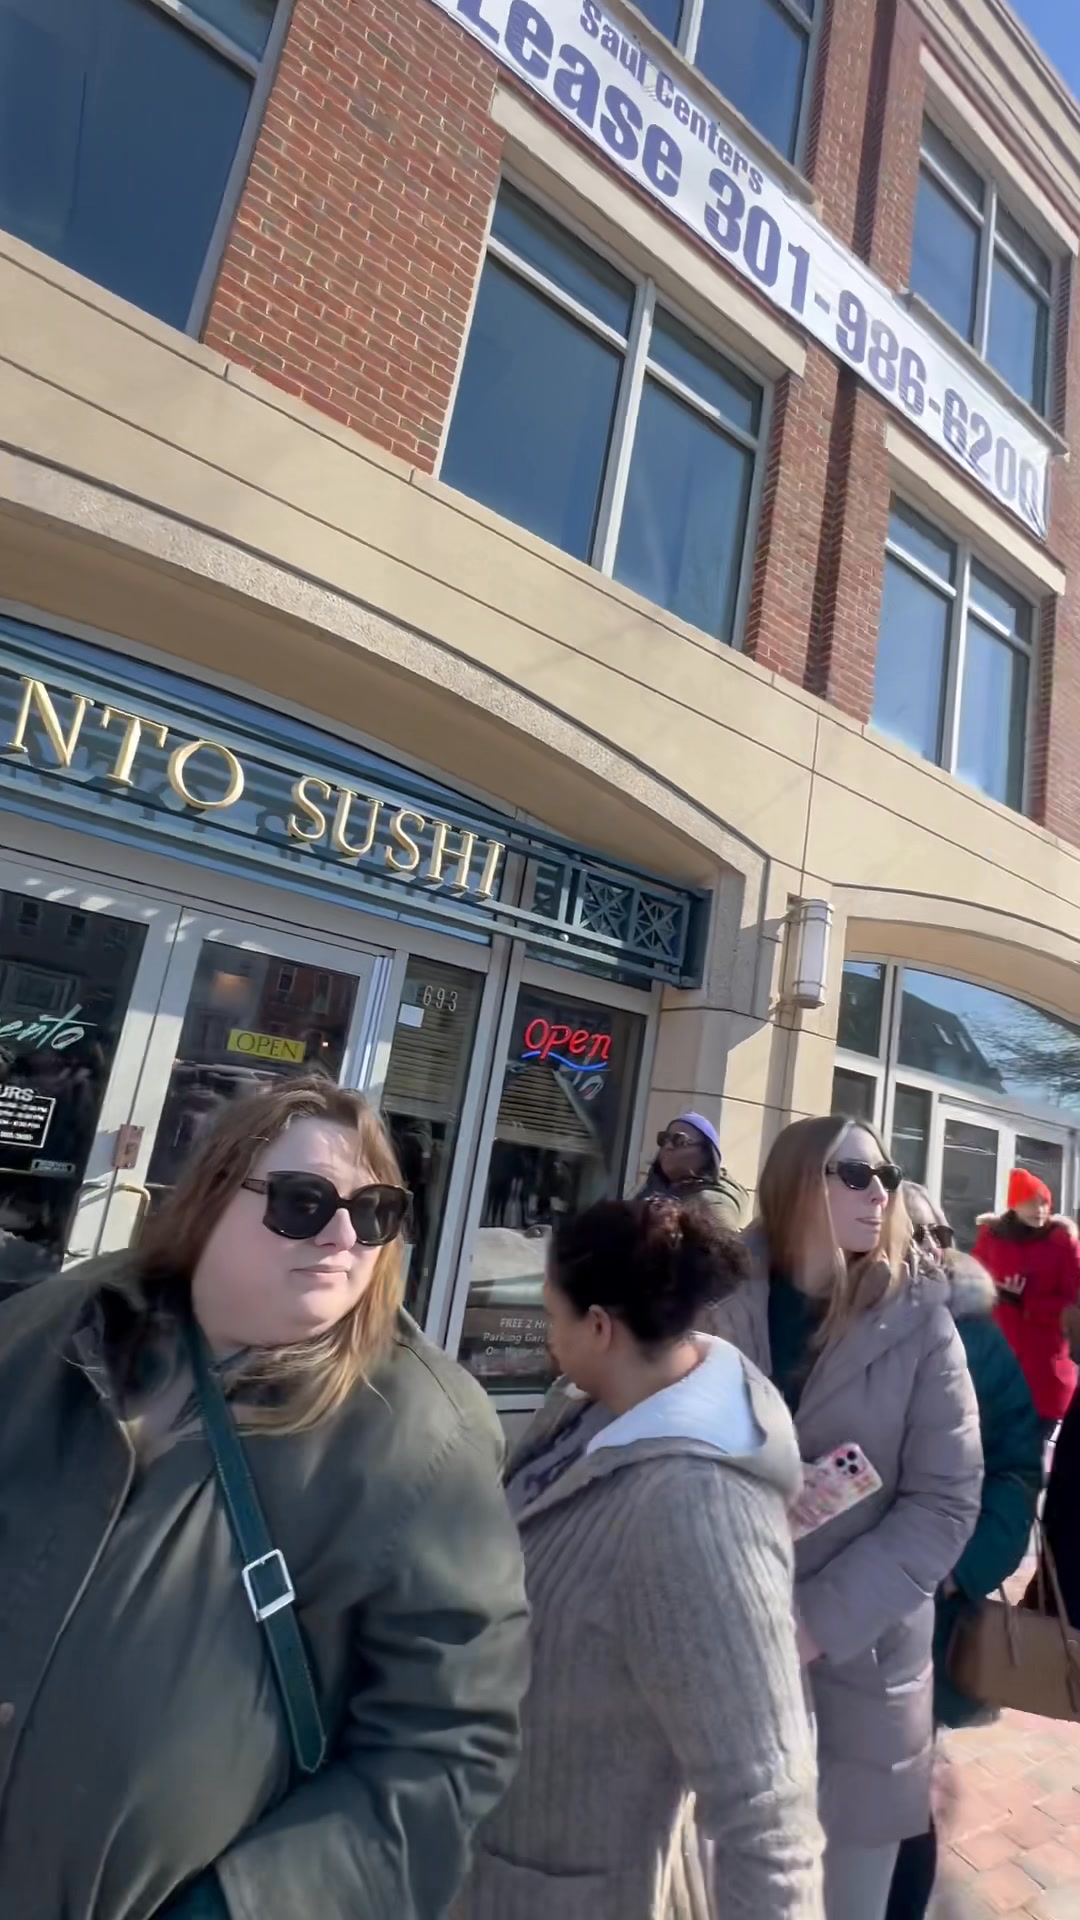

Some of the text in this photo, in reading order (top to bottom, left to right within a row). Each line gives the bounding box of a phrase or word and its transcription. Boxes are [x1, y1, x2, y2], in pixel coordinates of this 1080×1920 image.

[655, 70, 764, 196] Centers
[6, 676, 506, 899] NTO SUSHI
[423, 985, 458, 1012] 693
[236, 1032, 297, 1060] OPEN
[500, 1318, 524, 1328] FREE
